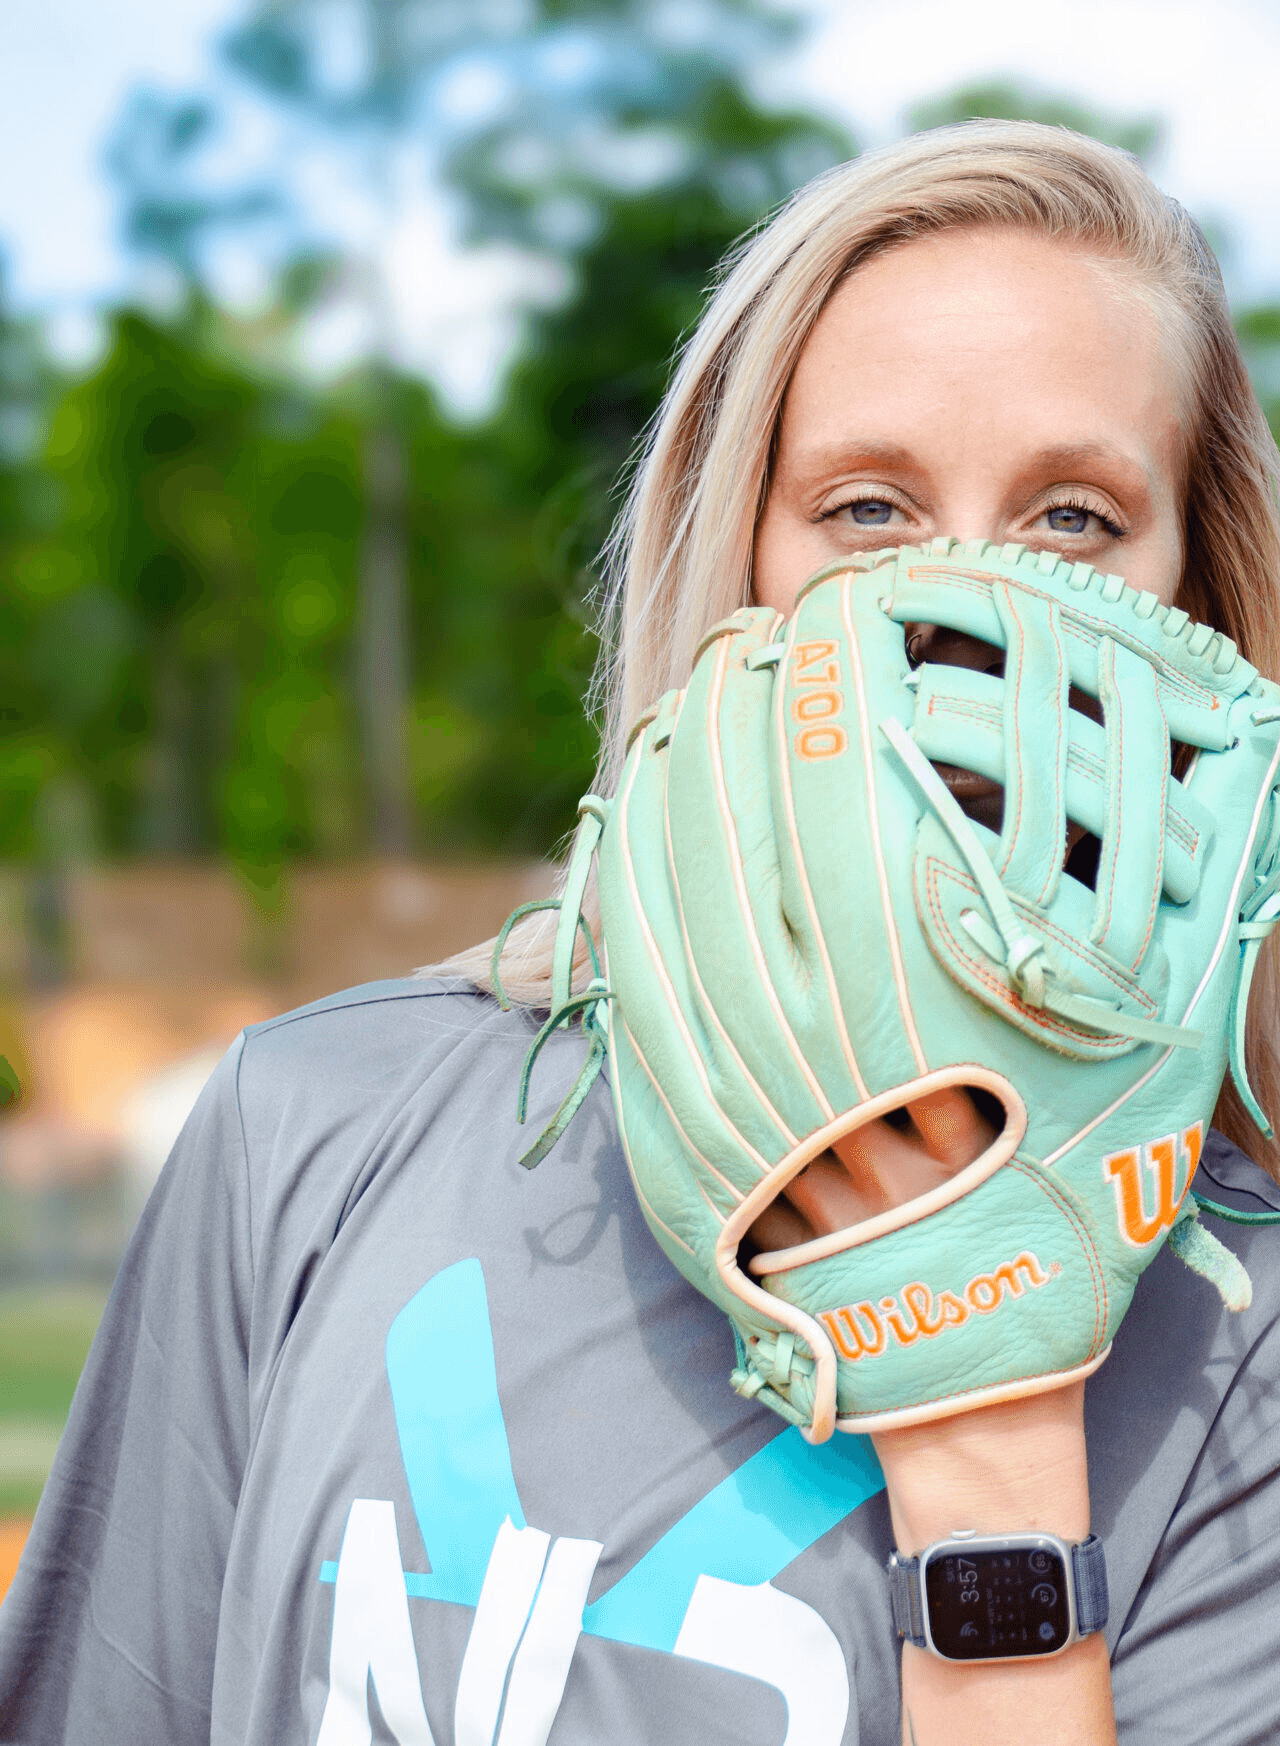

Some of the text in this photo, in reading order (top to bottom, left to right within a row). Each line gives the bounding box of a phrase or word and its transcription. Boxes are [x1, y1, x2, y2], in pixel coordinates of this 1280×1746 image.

[790, 638, 848, 763] A700
[816, 1251, 1051, 1361] Wilson
[958, 1558, 979, 1603] 3:57
